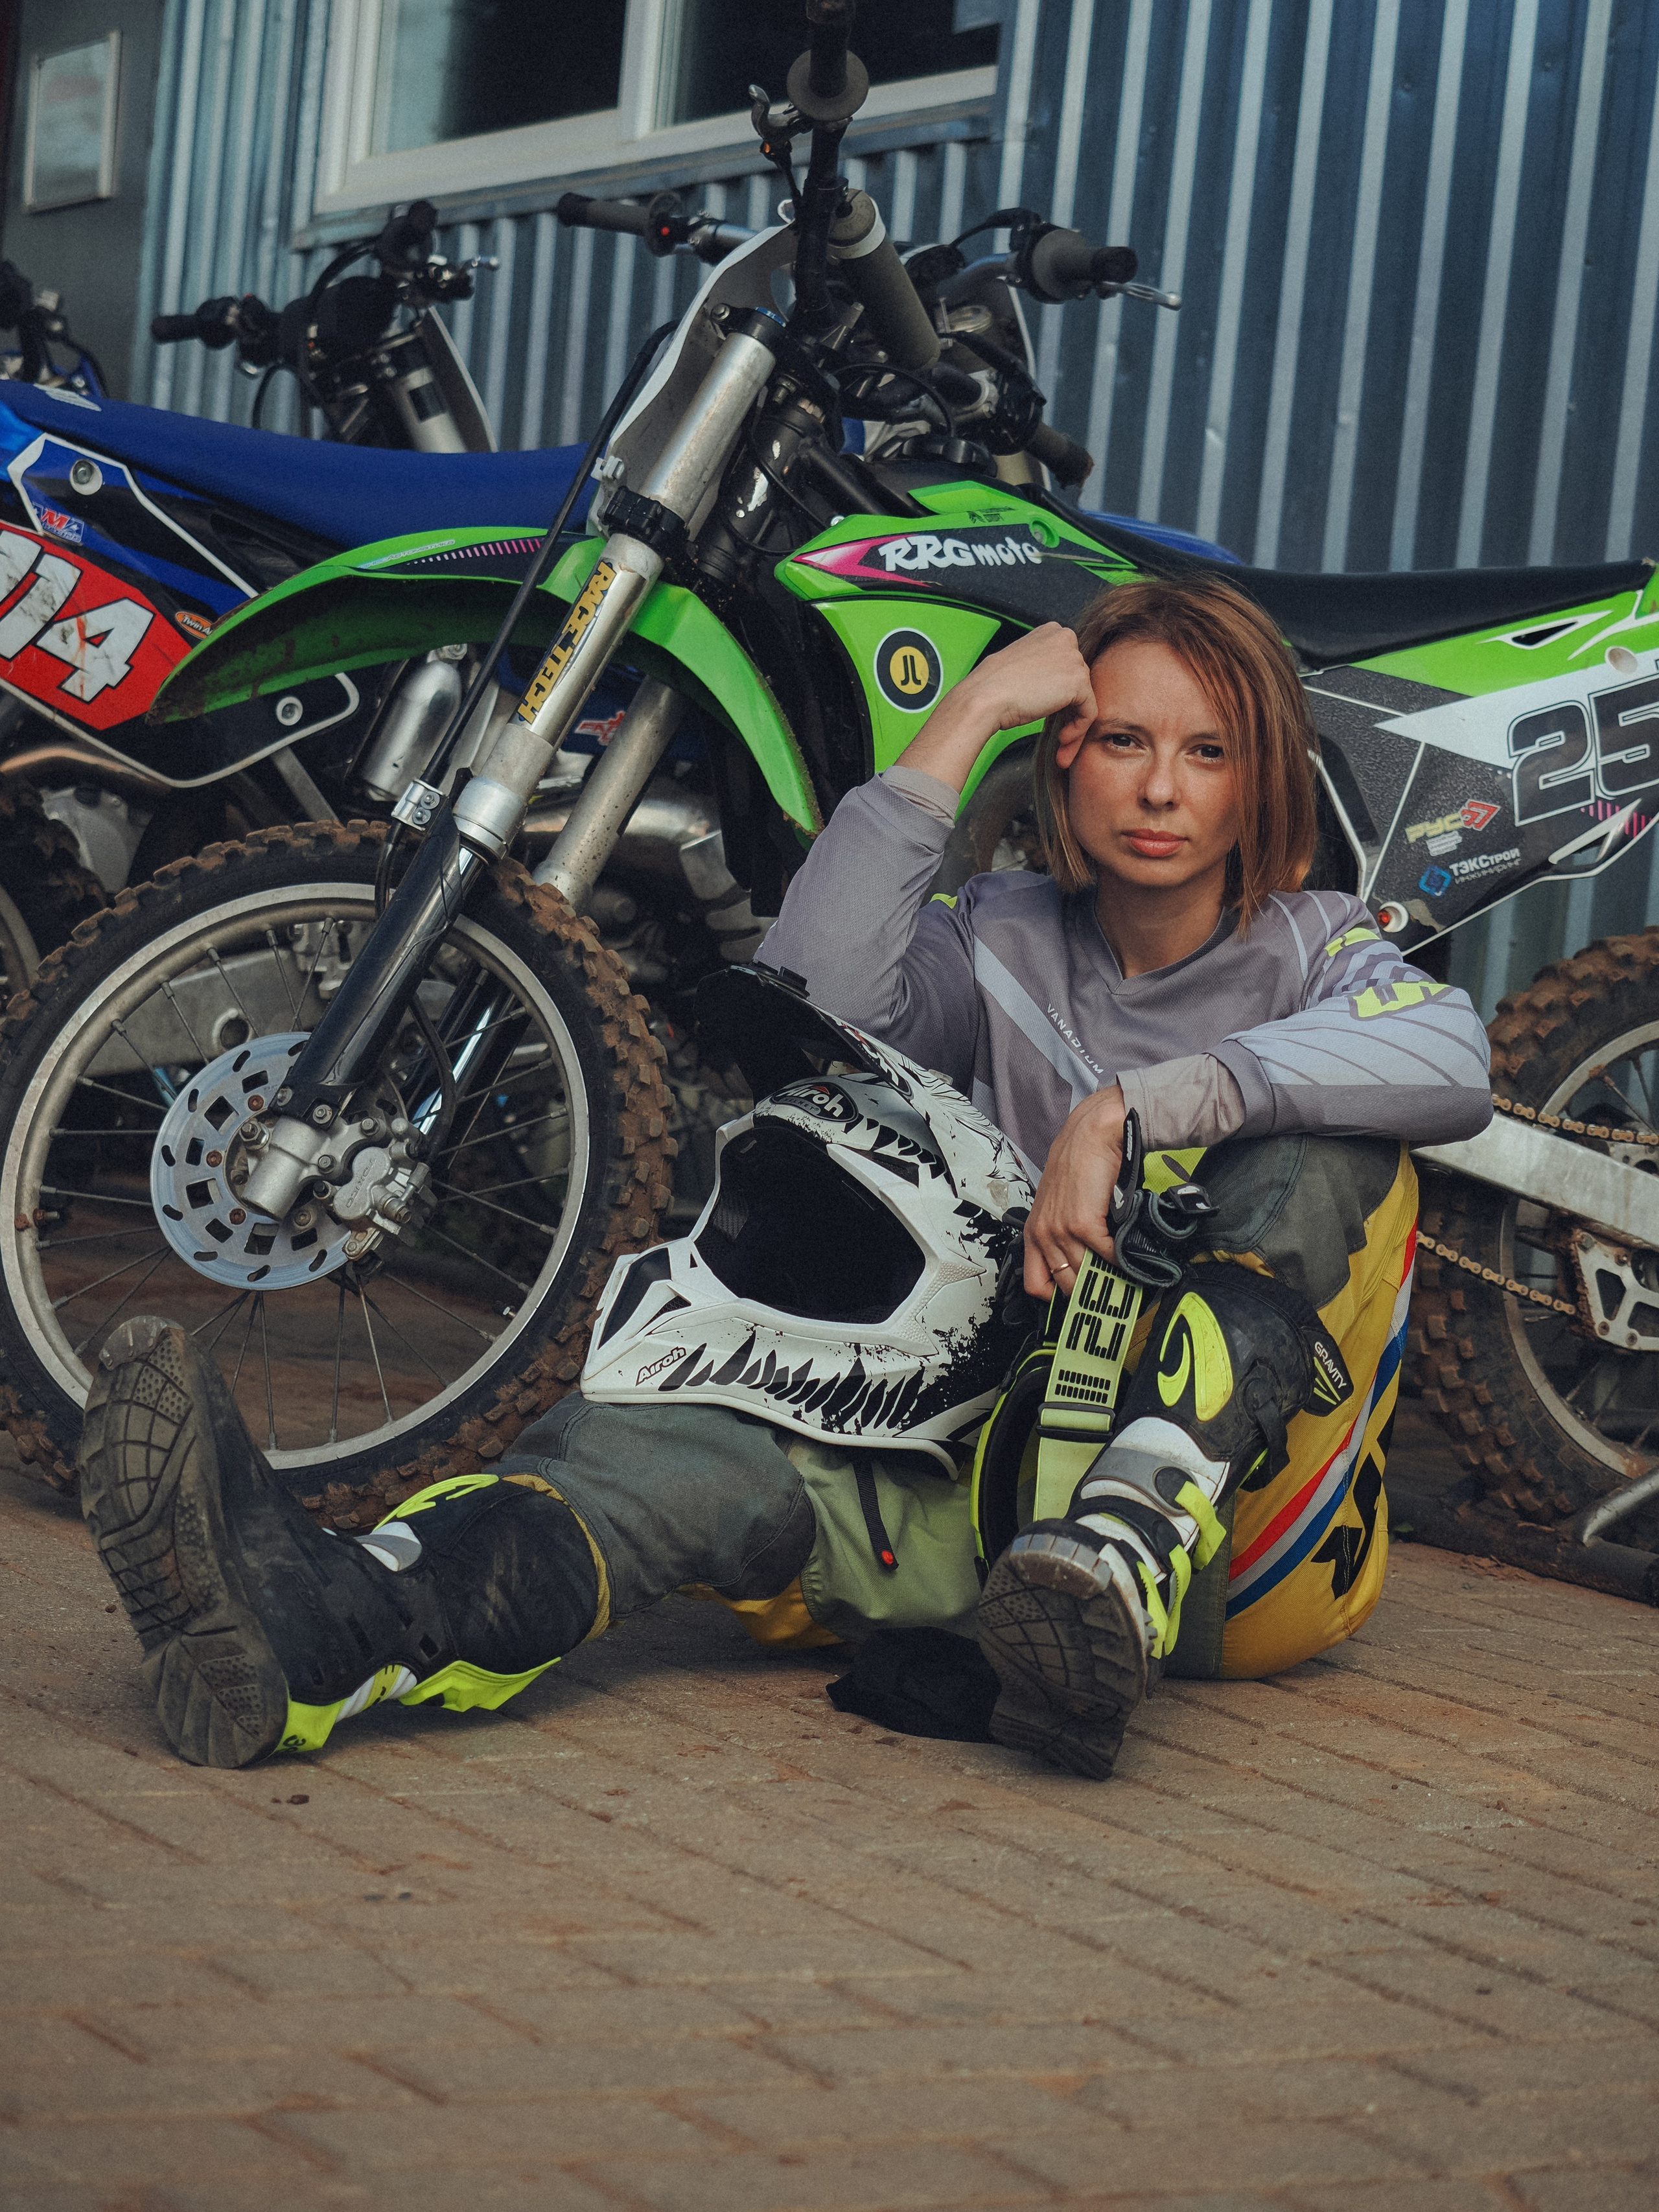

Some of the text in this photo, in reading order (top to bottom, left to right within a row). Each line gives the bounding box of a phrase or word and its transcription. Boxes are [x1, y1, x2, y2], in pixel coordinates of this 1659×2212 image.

[1507, 670, 1659, 828] 25
[1047, 1003, 1104, 1074] VANADIUM
[775, 1084, 844, 1118] Airoh
[635, 1346, 687, 1387] Airoh
[1314, 1341, 1347, 1389] GRAVITY
